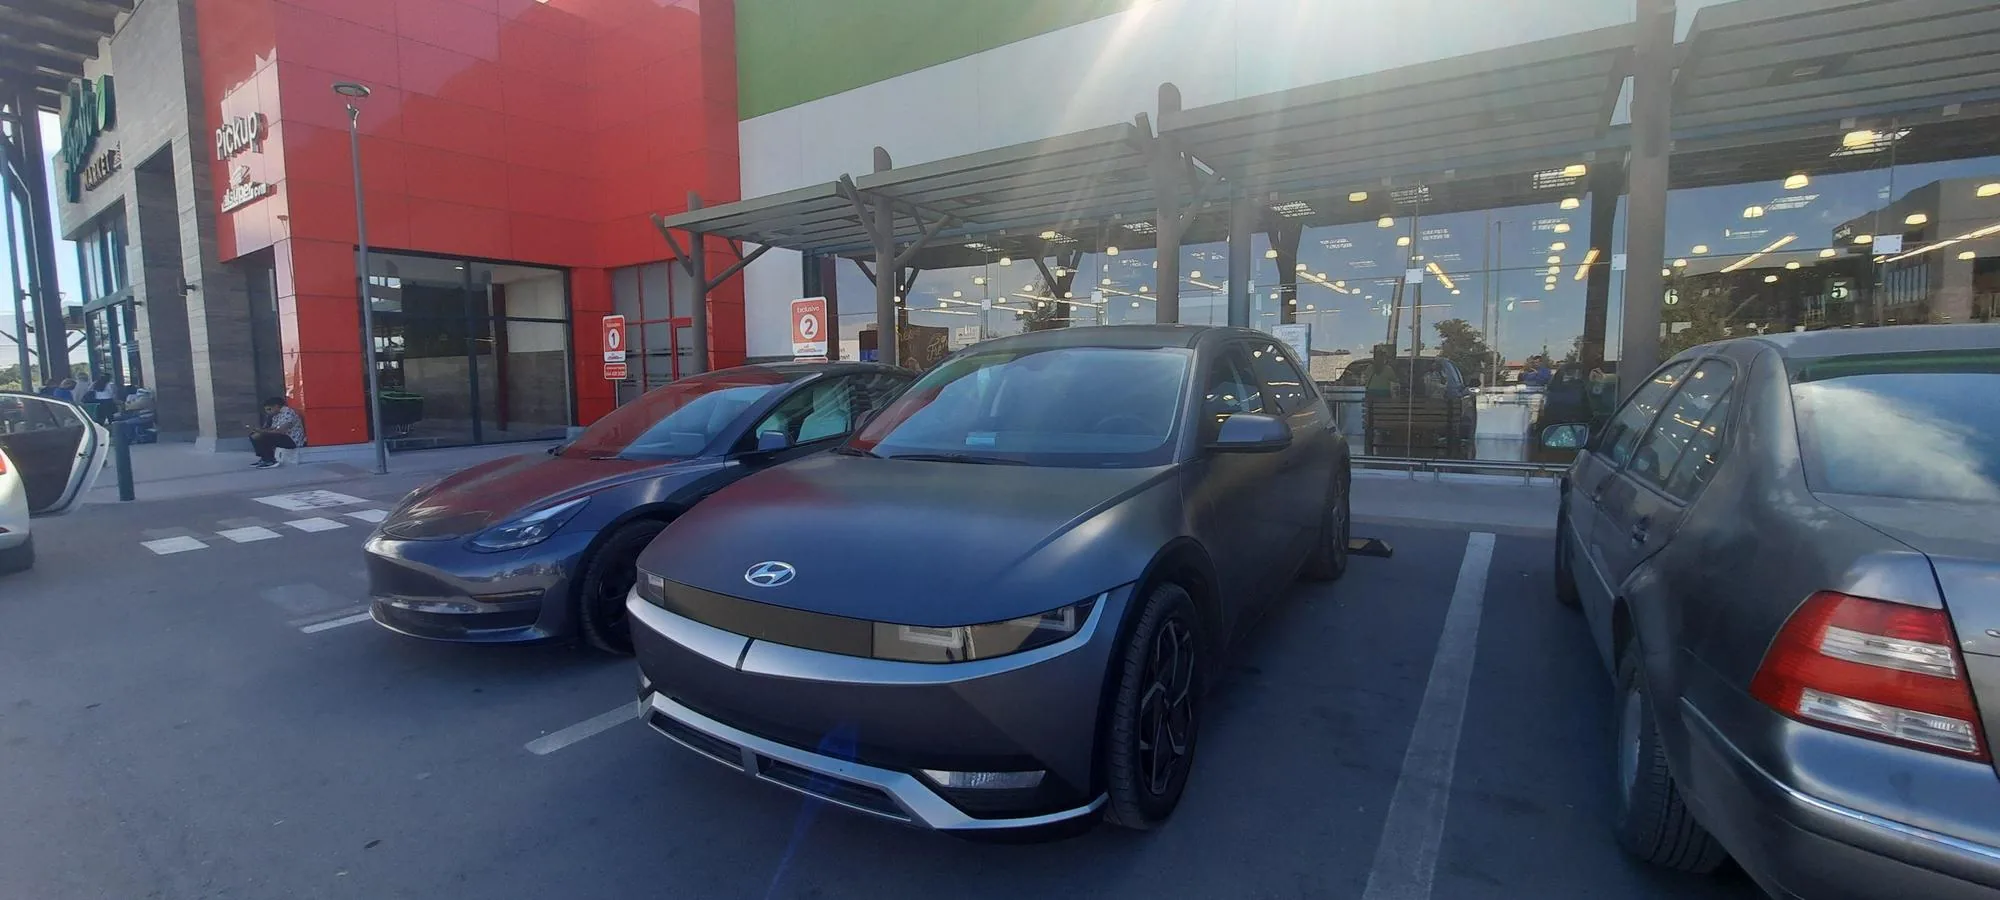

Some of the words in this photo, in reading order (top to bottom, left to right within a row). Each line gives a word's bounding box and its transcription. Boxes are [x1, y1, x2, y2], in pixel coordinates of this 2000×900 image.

[216, 112, 258, 160] Pickup
[1664, 289, 1679, 305] 6
[1831, 281, 1848, 298] 5
[804, 318, 814, 335] 2
